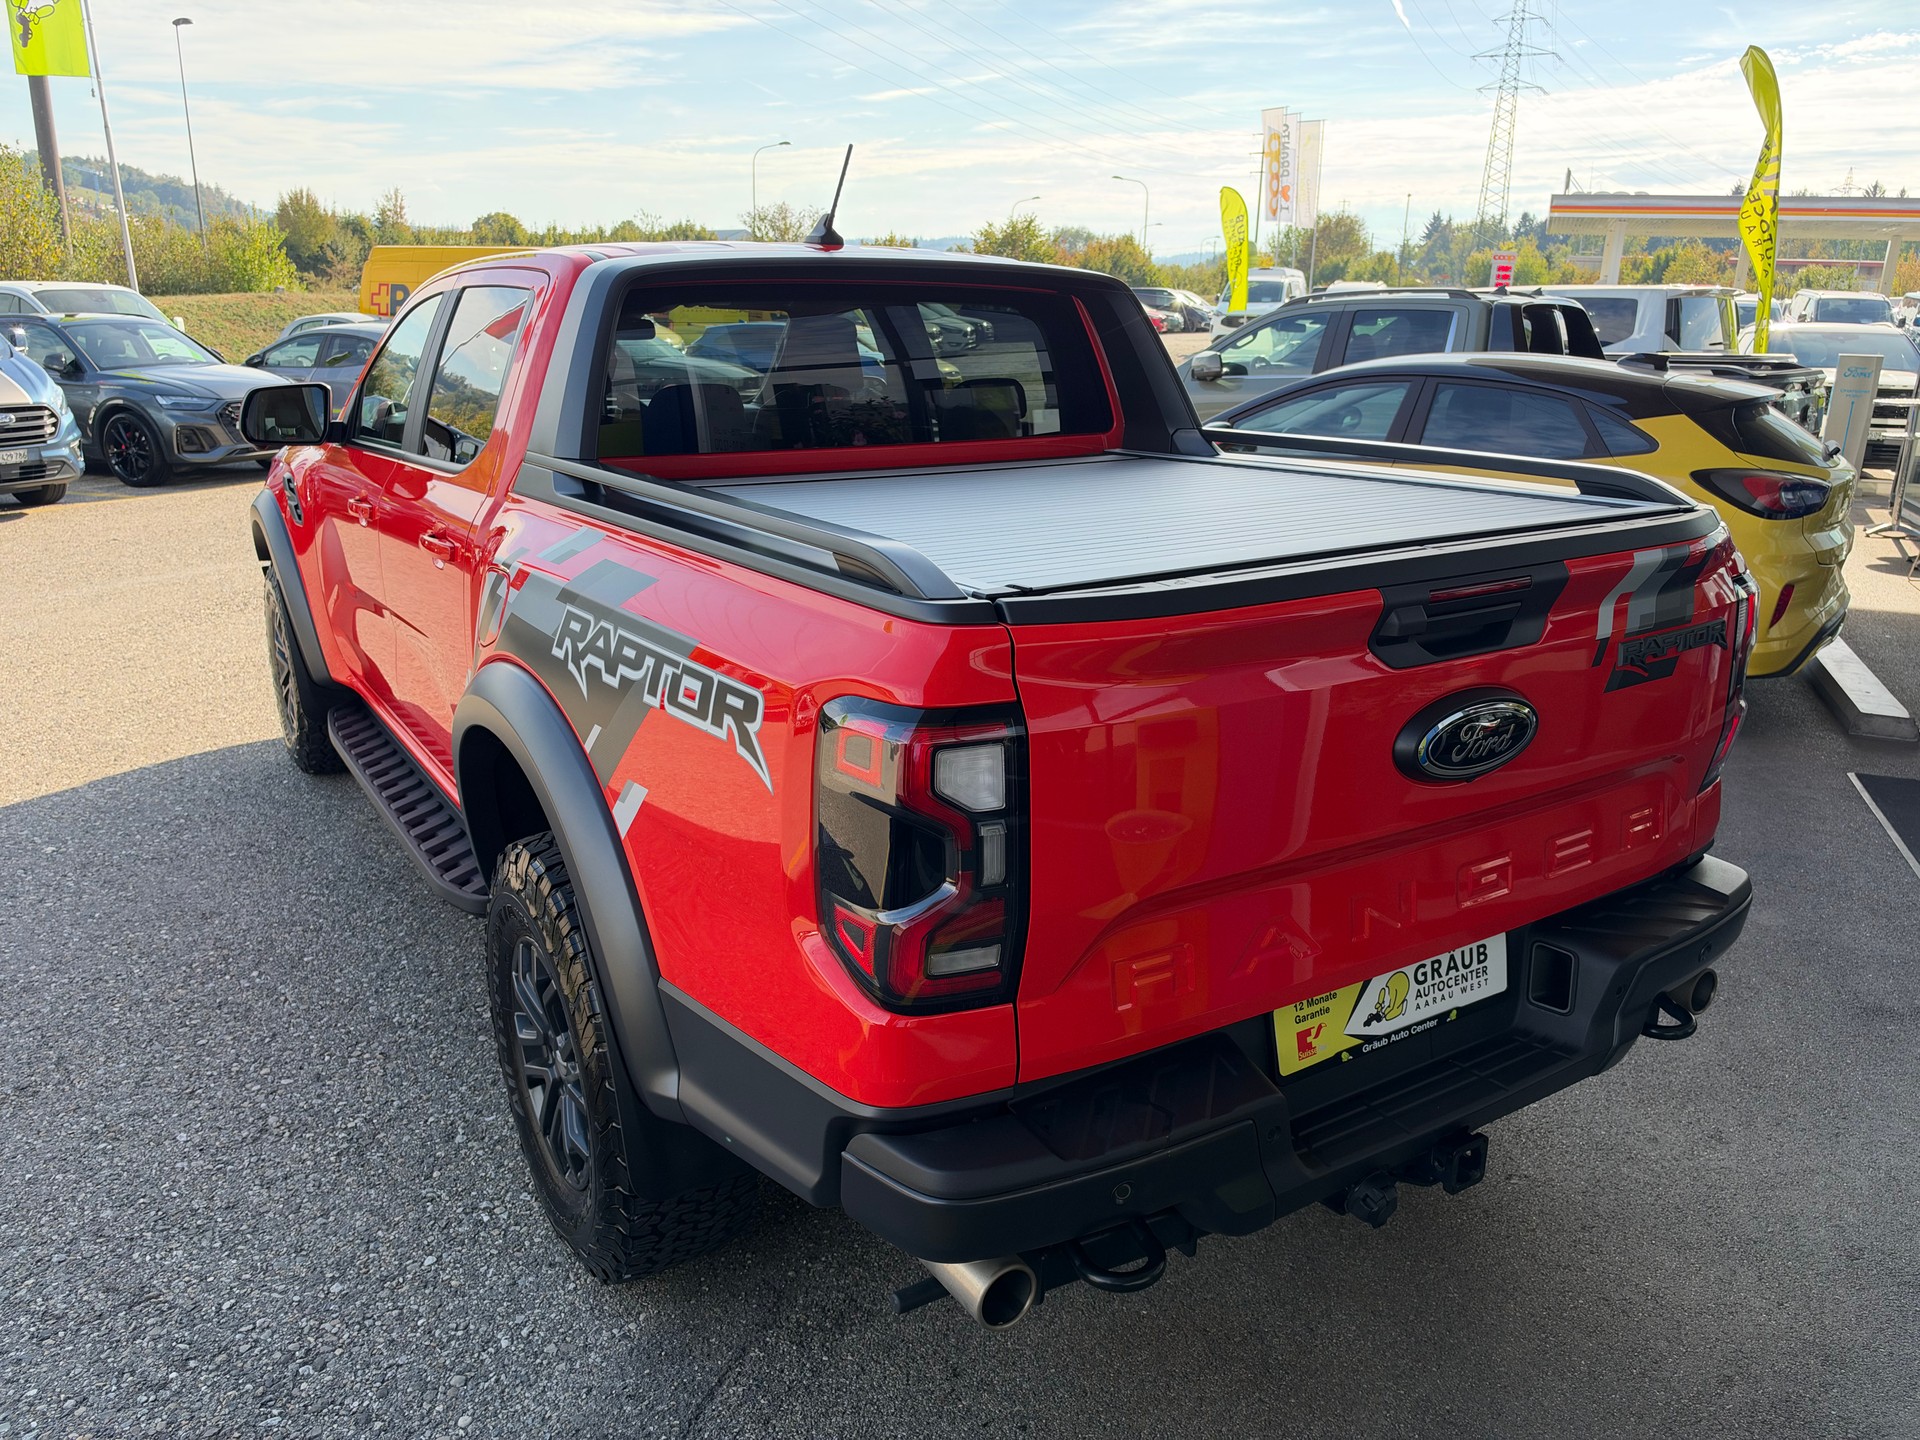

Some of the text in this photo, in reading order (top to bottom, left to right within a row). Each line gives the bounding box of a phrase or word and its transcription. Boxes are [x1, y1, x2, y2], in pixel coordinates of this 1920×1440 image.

[1493, 254, 1516, 262] coop
[1843, 366, 1874, 378] Ford
[1617, 617, 1728, 676] RAPTOR
[551, 603, 774, 796] RAPTOR
[1451, 718, 1515, 763] Ford
[1112, 806, 1661, 1011] RANGER
[1413, 943, 1488, 985] GRÄUB
[1415, 965, 1489, 1001] AUTOCENTER
[1415, 978, 1489, 1011] AARAU WEST
[1293, 991, 1338, 1012] 12 Monate
[1294, 1005, 1331, 1024] Garantie
[1362, 1018, 1439, 1053] Gräub Auto Center
